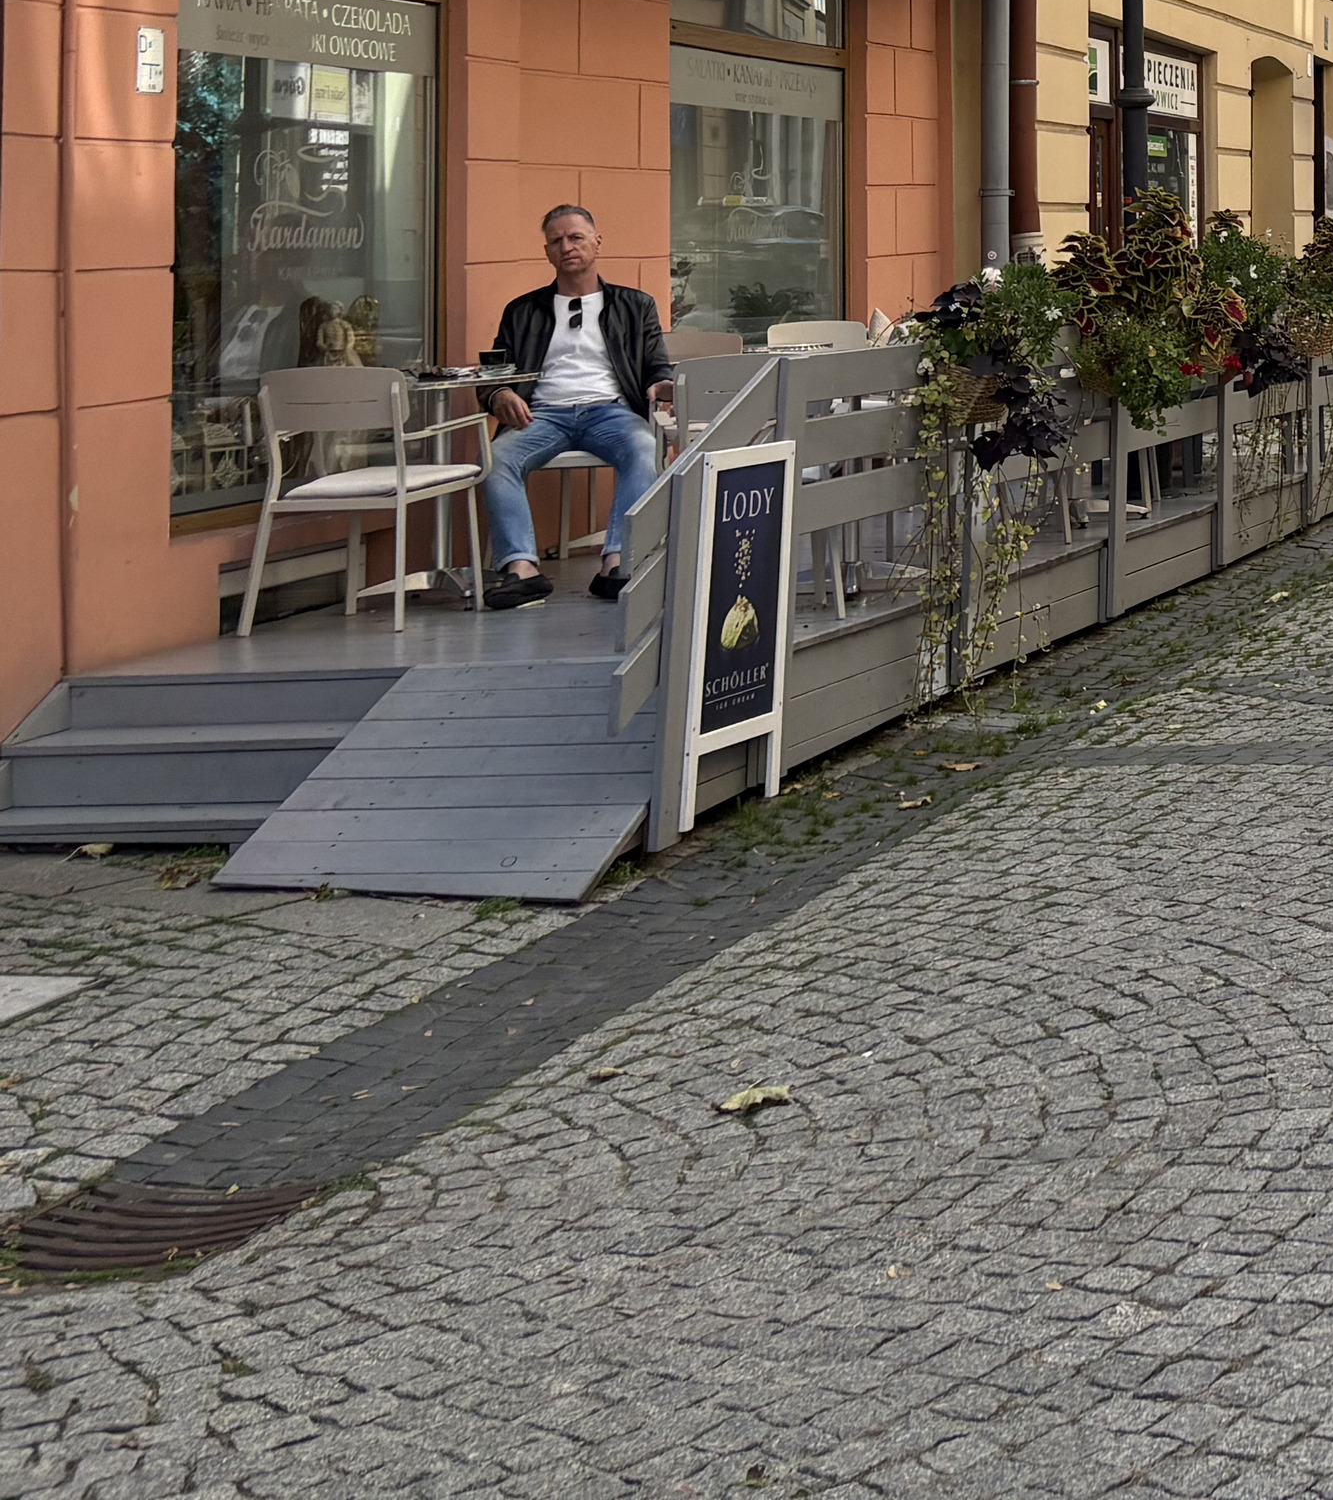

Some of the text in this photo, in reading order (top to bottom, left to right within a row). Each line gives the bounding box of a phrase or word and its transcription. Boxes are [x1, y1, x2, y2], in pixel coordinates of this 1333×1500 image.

[331, 3, 413, 35] CZEKOLADA
[329, 34, 397, 62] OWOCOWE
[1144, 59, 1196, 91] PIECZENIA
[248, 212, 365, 252] Kardamon
[721, 486, 775, 523] LODY
[705, 665, 768, 698] SCHÖLLER
